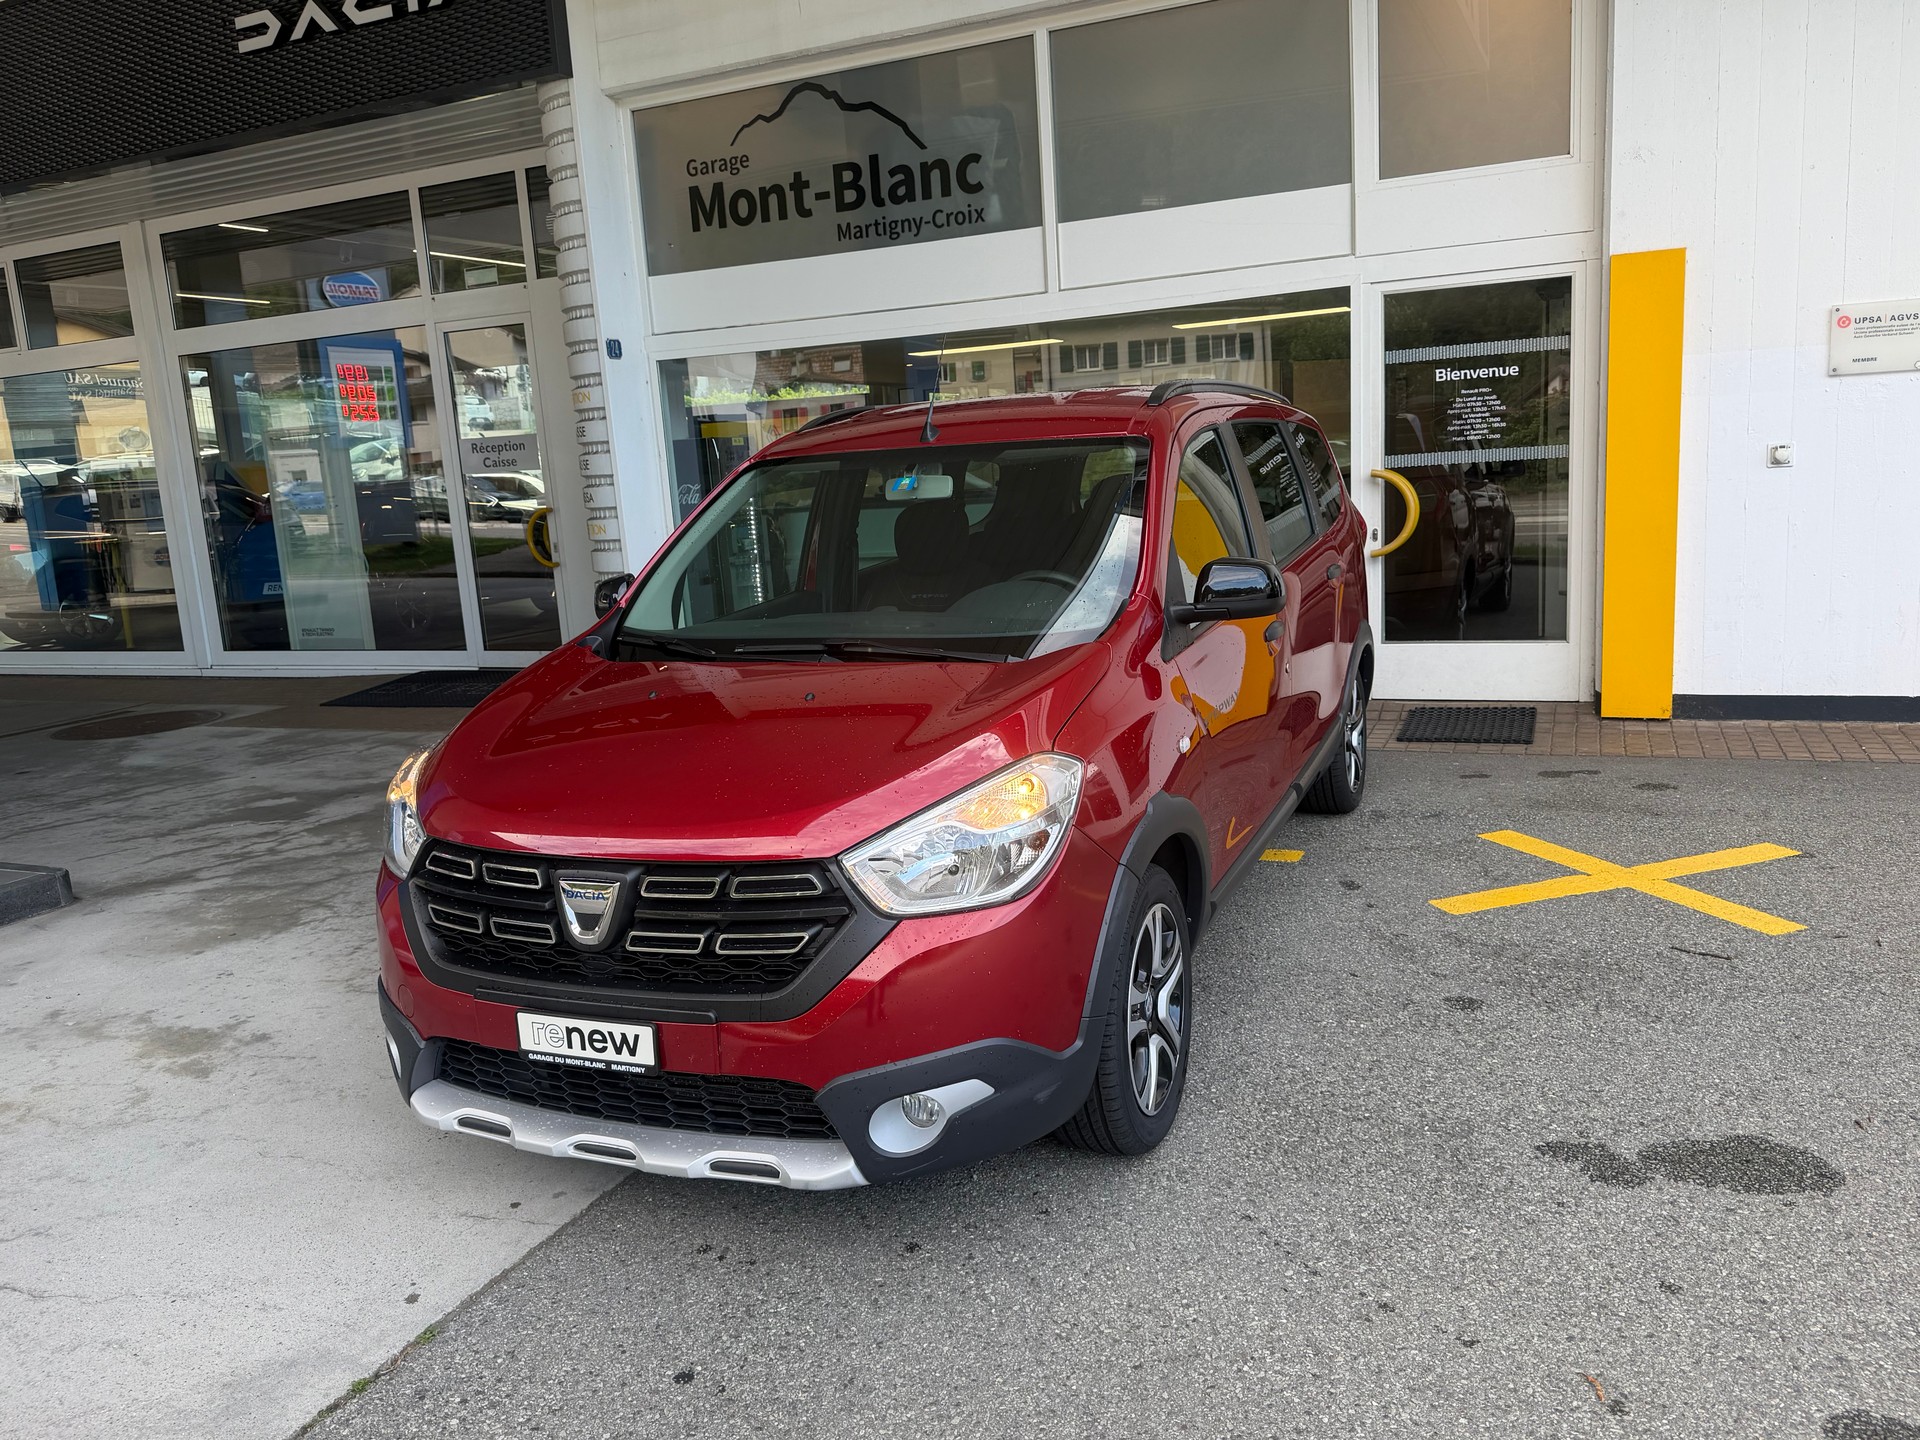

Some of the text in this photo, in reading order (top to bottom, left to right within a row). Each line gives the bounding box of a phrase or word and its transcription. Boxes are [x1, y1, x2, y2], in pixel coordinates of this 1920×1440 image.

[686, 154, 750, 177] Garage
[688, 152, 985, 232] Mont-Blanc
[837, 204, 986, 242] Martigny-Croix
[1854, 313, 1919, 324] UPSA AGVS
[1435, 365, 1519, 382] Bienvenue
[471, 441, 526, 455] Réception
[483, 457, 518, 468] Caisse
[565, 890, 606, 901] DACIA
[531, 1021, 640, 1057] renew
[528, 1053, 555, 1063] GARAGE
[565, 1058, 606, 1069] MONT-BLANC
[611, 1063, 646, 1074] MARTIGNY
